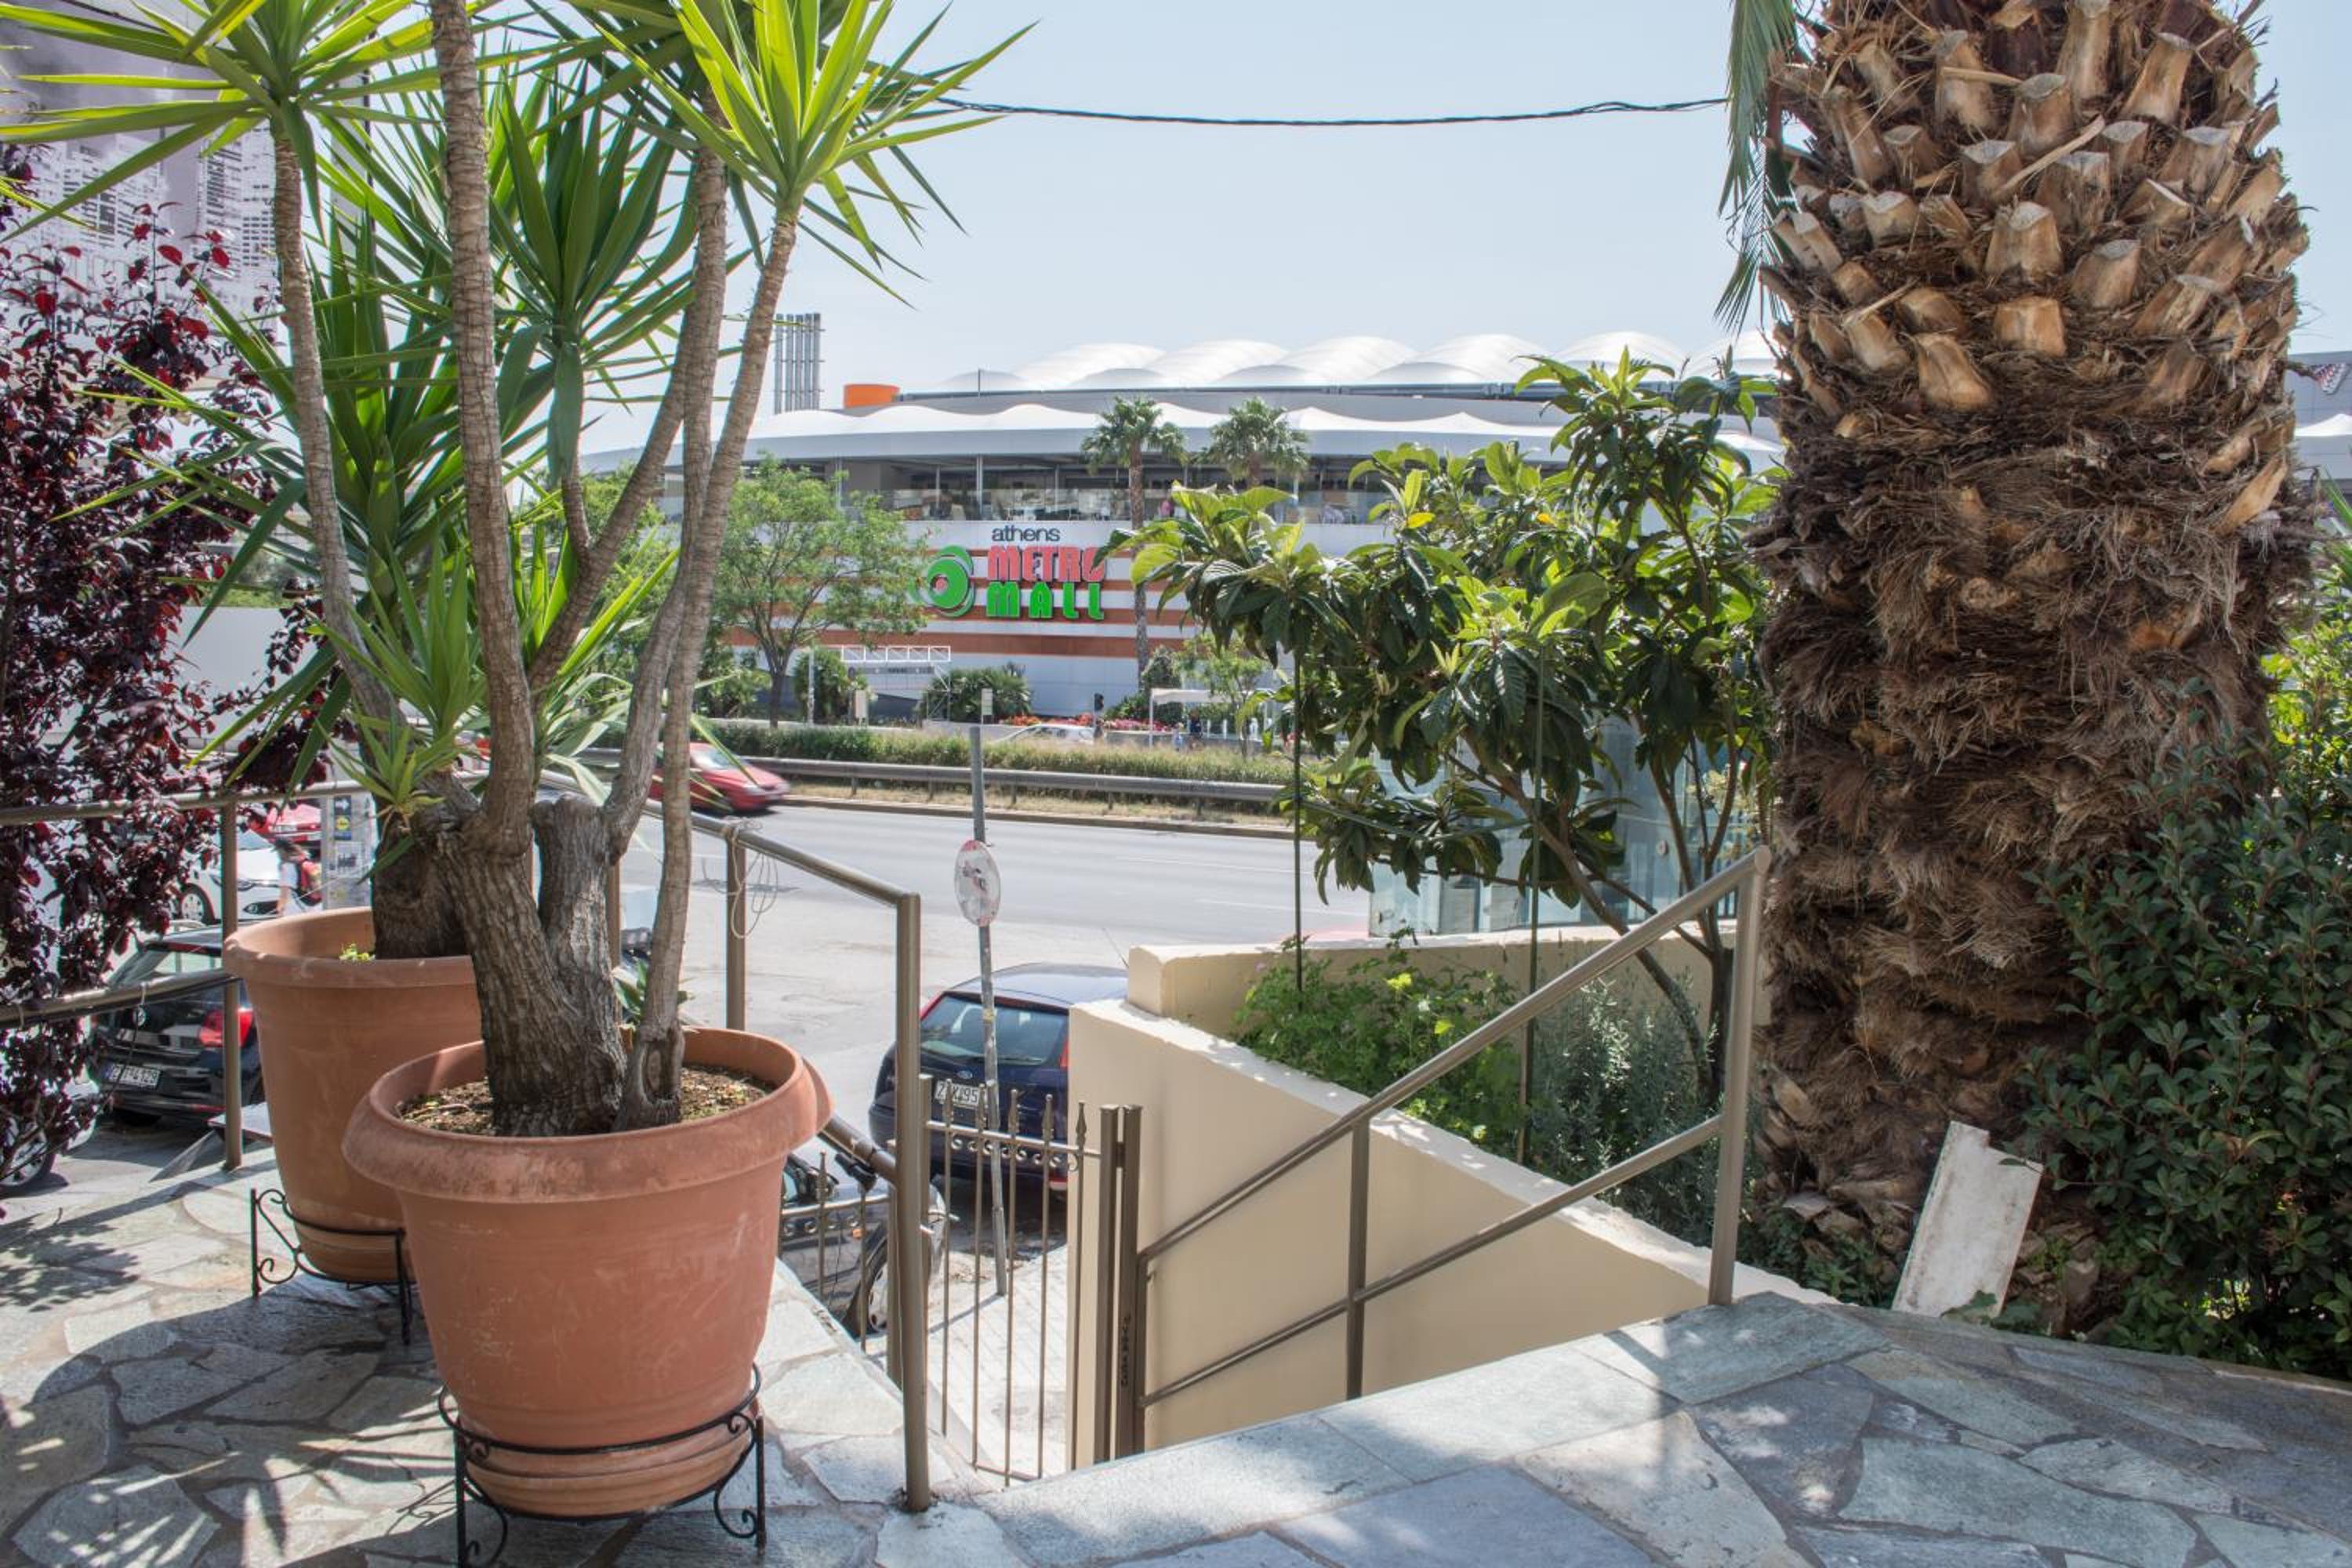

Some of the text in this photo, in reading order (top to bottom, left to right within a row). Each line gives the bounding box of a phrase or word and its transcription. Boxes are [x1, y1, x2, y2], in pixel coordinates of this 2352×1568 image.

[991, 524, 1061, 542] athens
[987, 545, 1105, 583] METRO
[986, 581, 1105, 620] MALL
